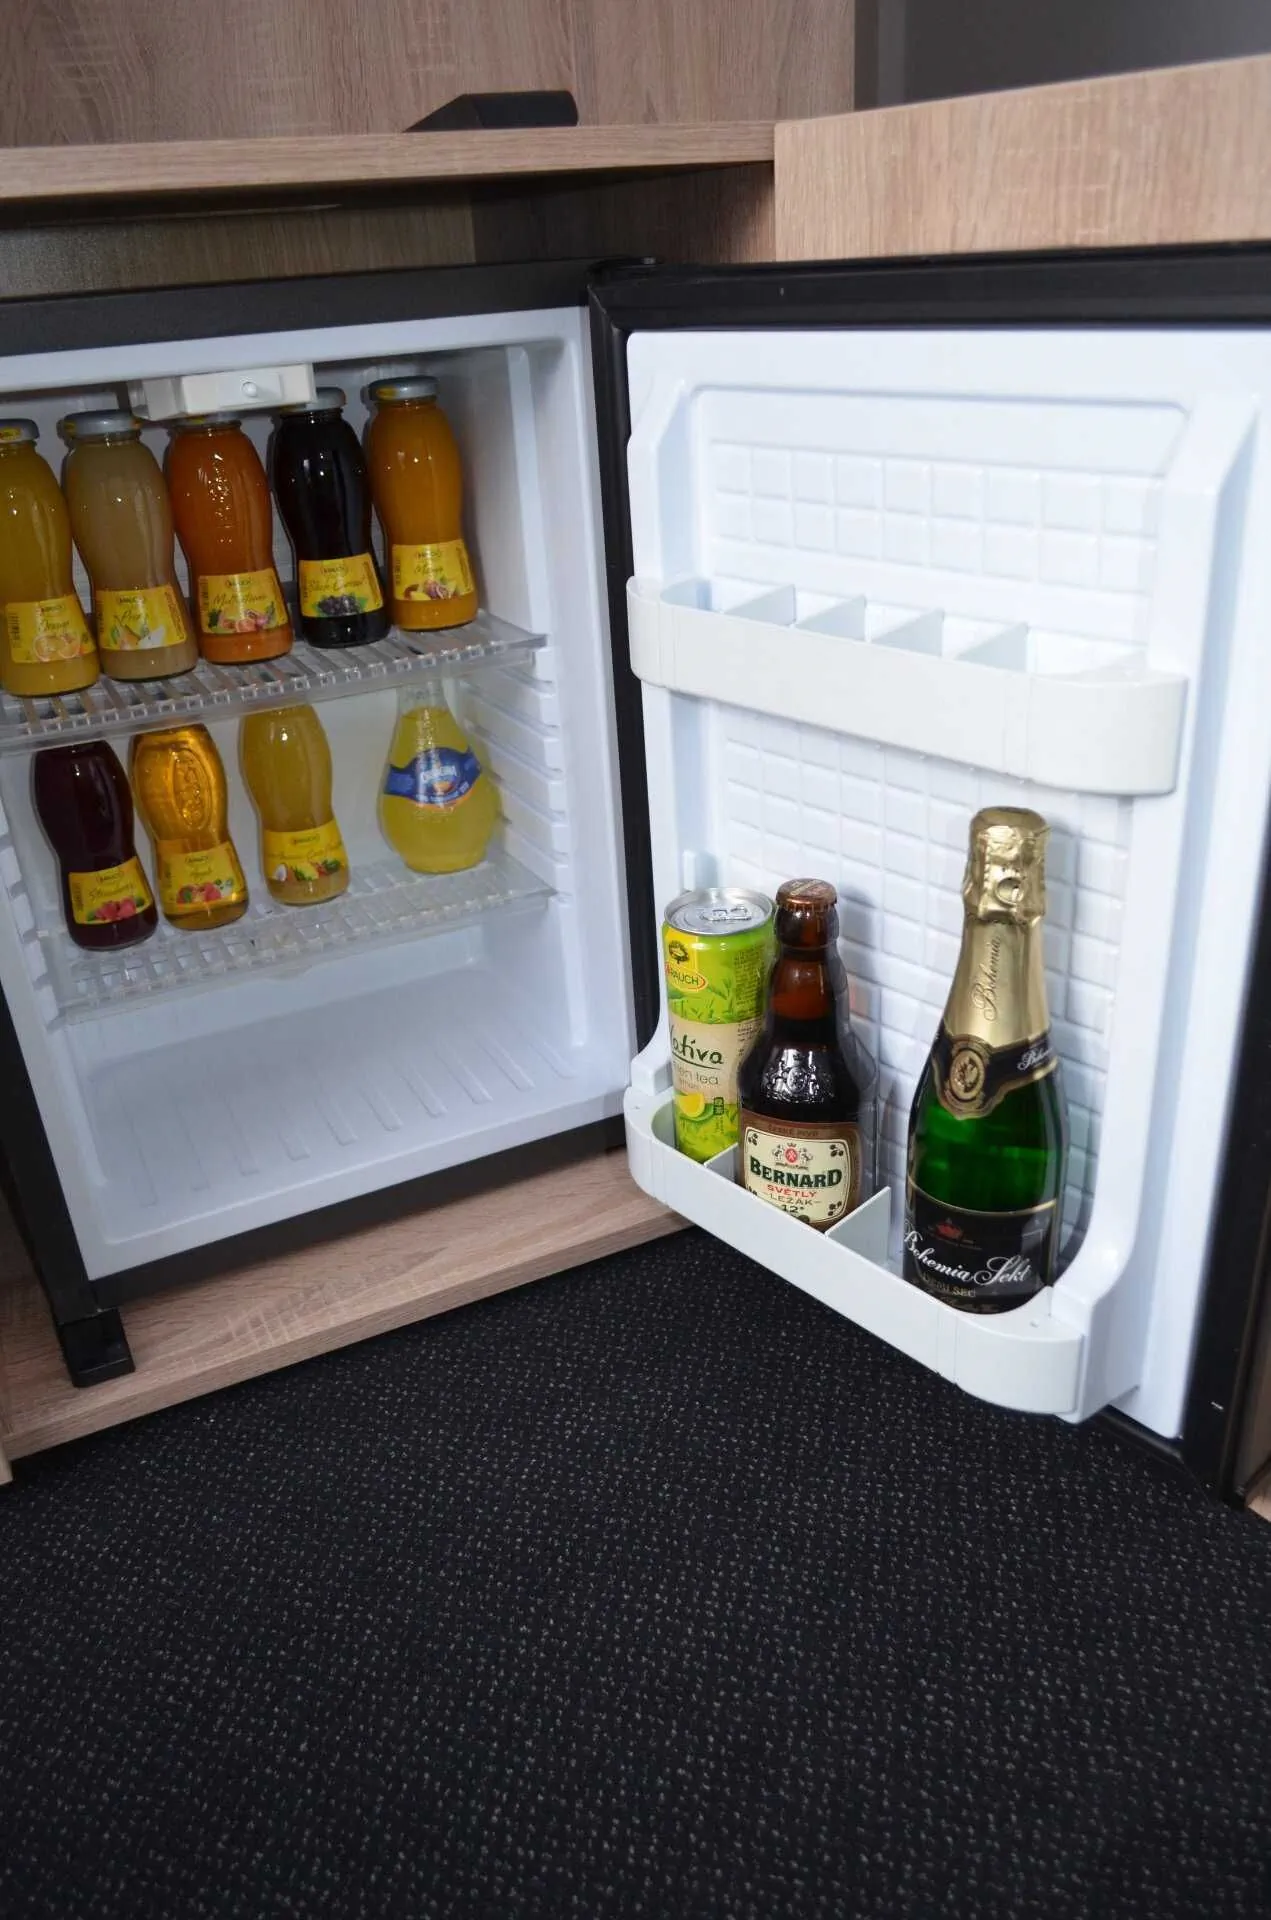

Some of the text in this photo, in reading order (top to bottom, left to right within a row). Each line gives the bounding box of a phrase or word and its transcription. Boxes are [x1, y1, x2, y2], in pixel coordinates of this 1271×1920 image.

[970, 936, 1002, 1022] Bohemia
[749, 1155, 843, 1188] BERNARD
[904, 1222, 974, 1282] Bohemia
[974, 1255, 1032, 1286] Sekt
